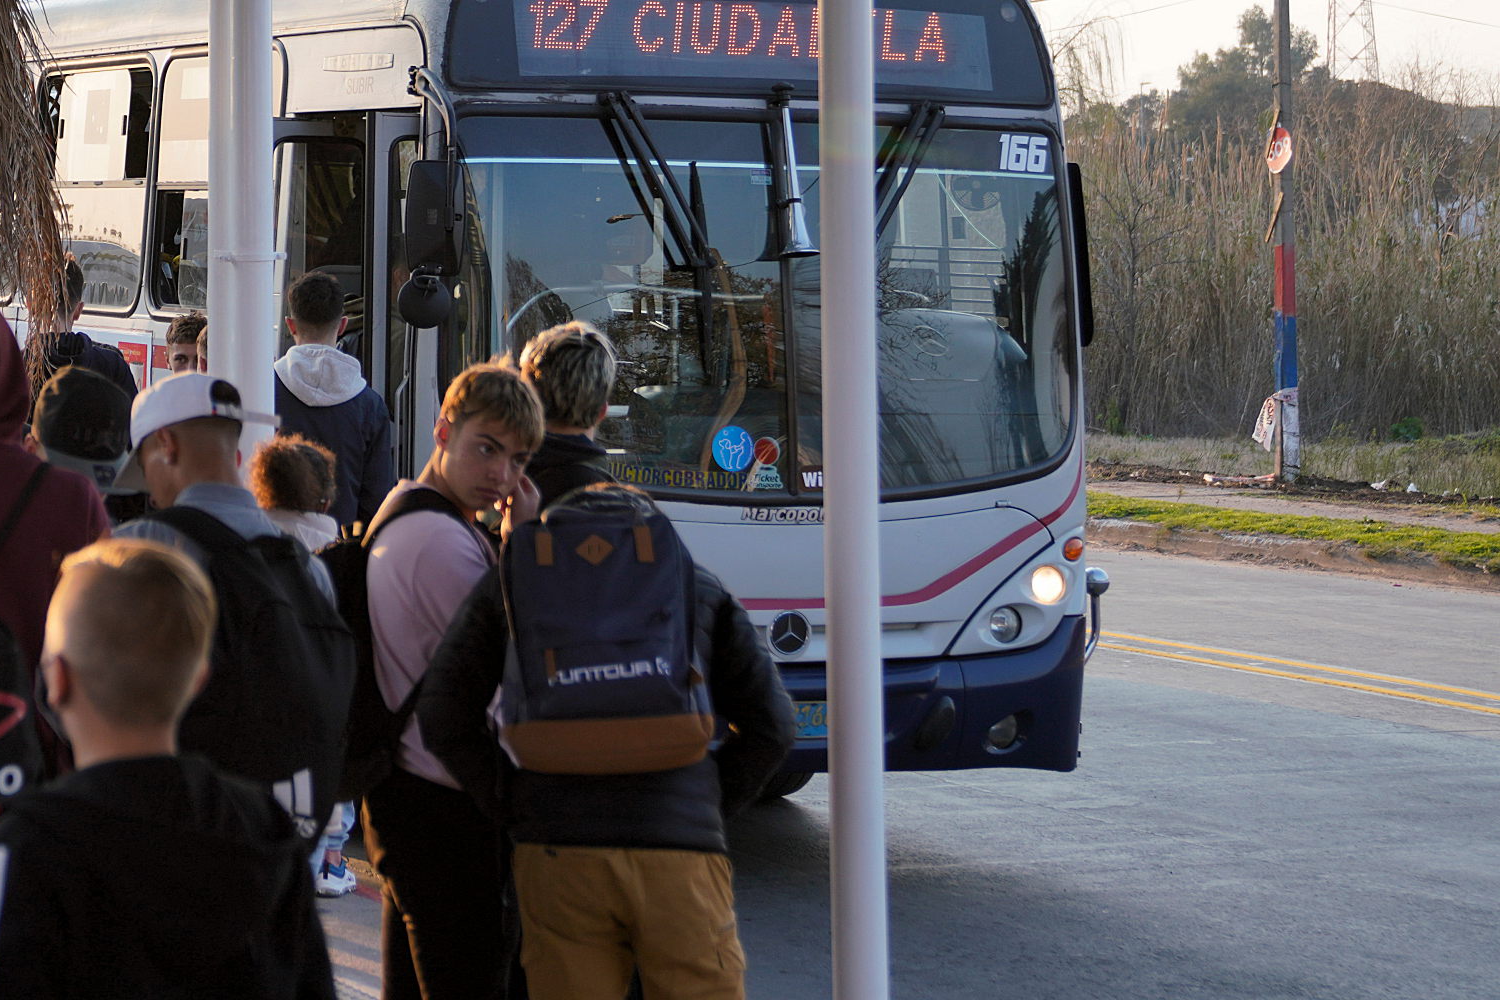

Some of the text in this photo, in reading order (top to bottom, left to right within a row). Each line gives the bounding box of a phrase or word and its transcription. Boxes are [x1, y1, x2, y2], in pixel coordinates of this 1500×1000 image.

[632, 1, 946, 62] CIUDALA
[346, 76, 374, 95] SUBIR
[999, 133, 1048, 173] 166
